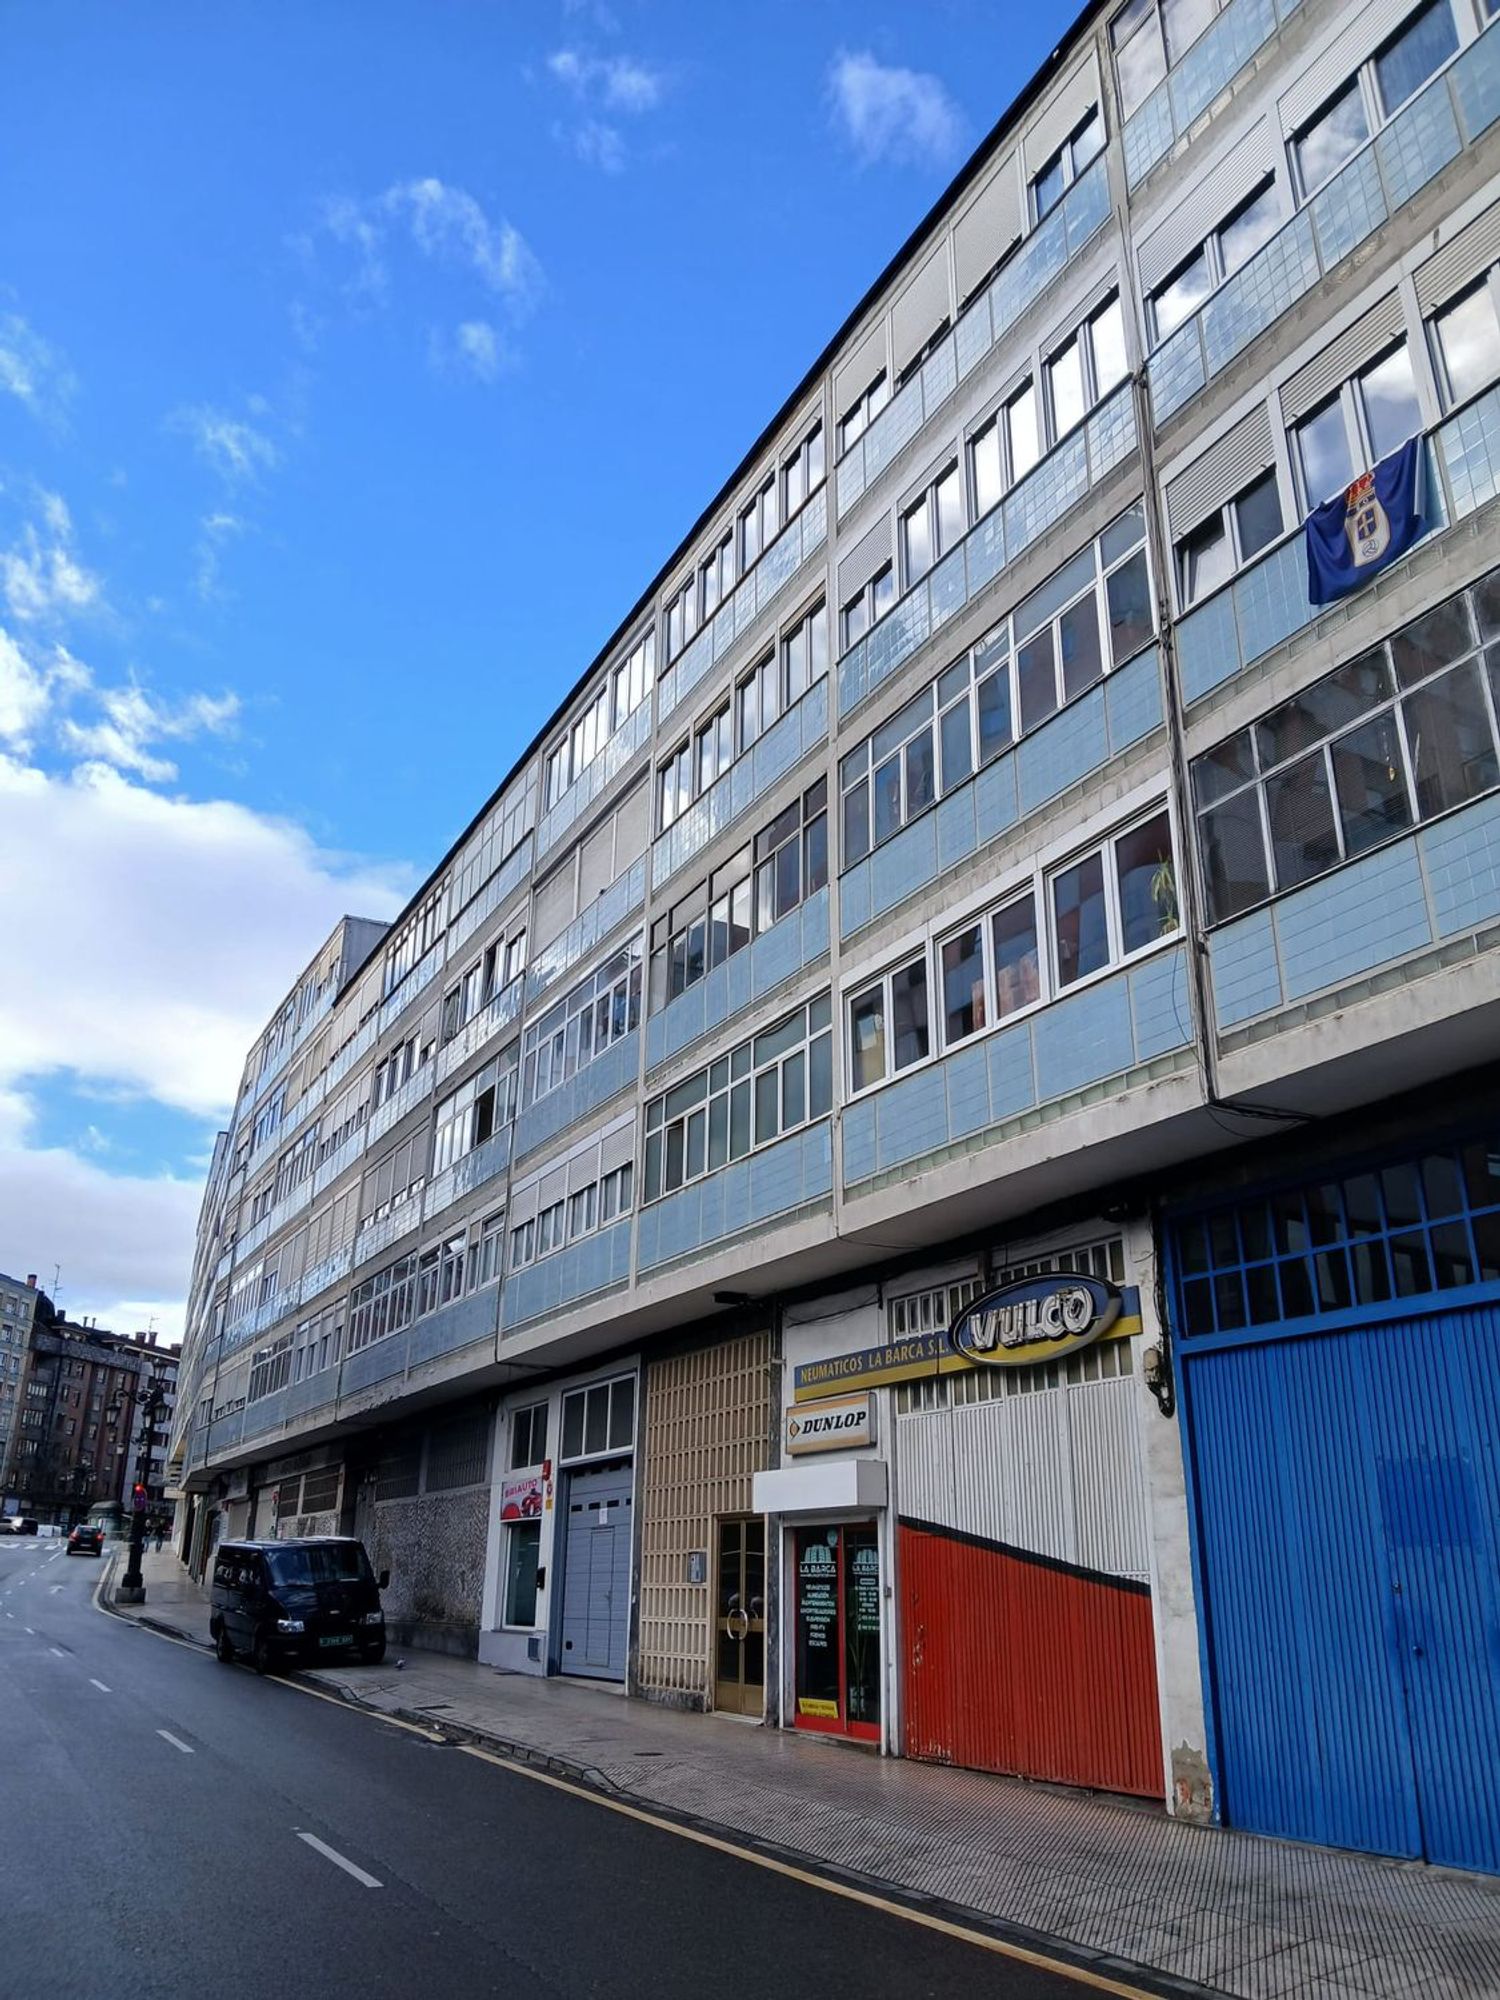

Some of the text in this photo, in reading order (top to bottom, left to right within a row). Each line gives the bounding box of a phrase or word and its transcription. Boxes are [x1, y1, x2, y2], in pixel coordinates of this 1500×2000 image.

[967, 1285, 1093, 1350] VULCO
[801, 1337, 949, 1382] NEUMATICOS LA BARCA S.L.
[802, 1411, 867, 1435] DUNLOP
[800, 1565, 836, 1573] LA BARCA
